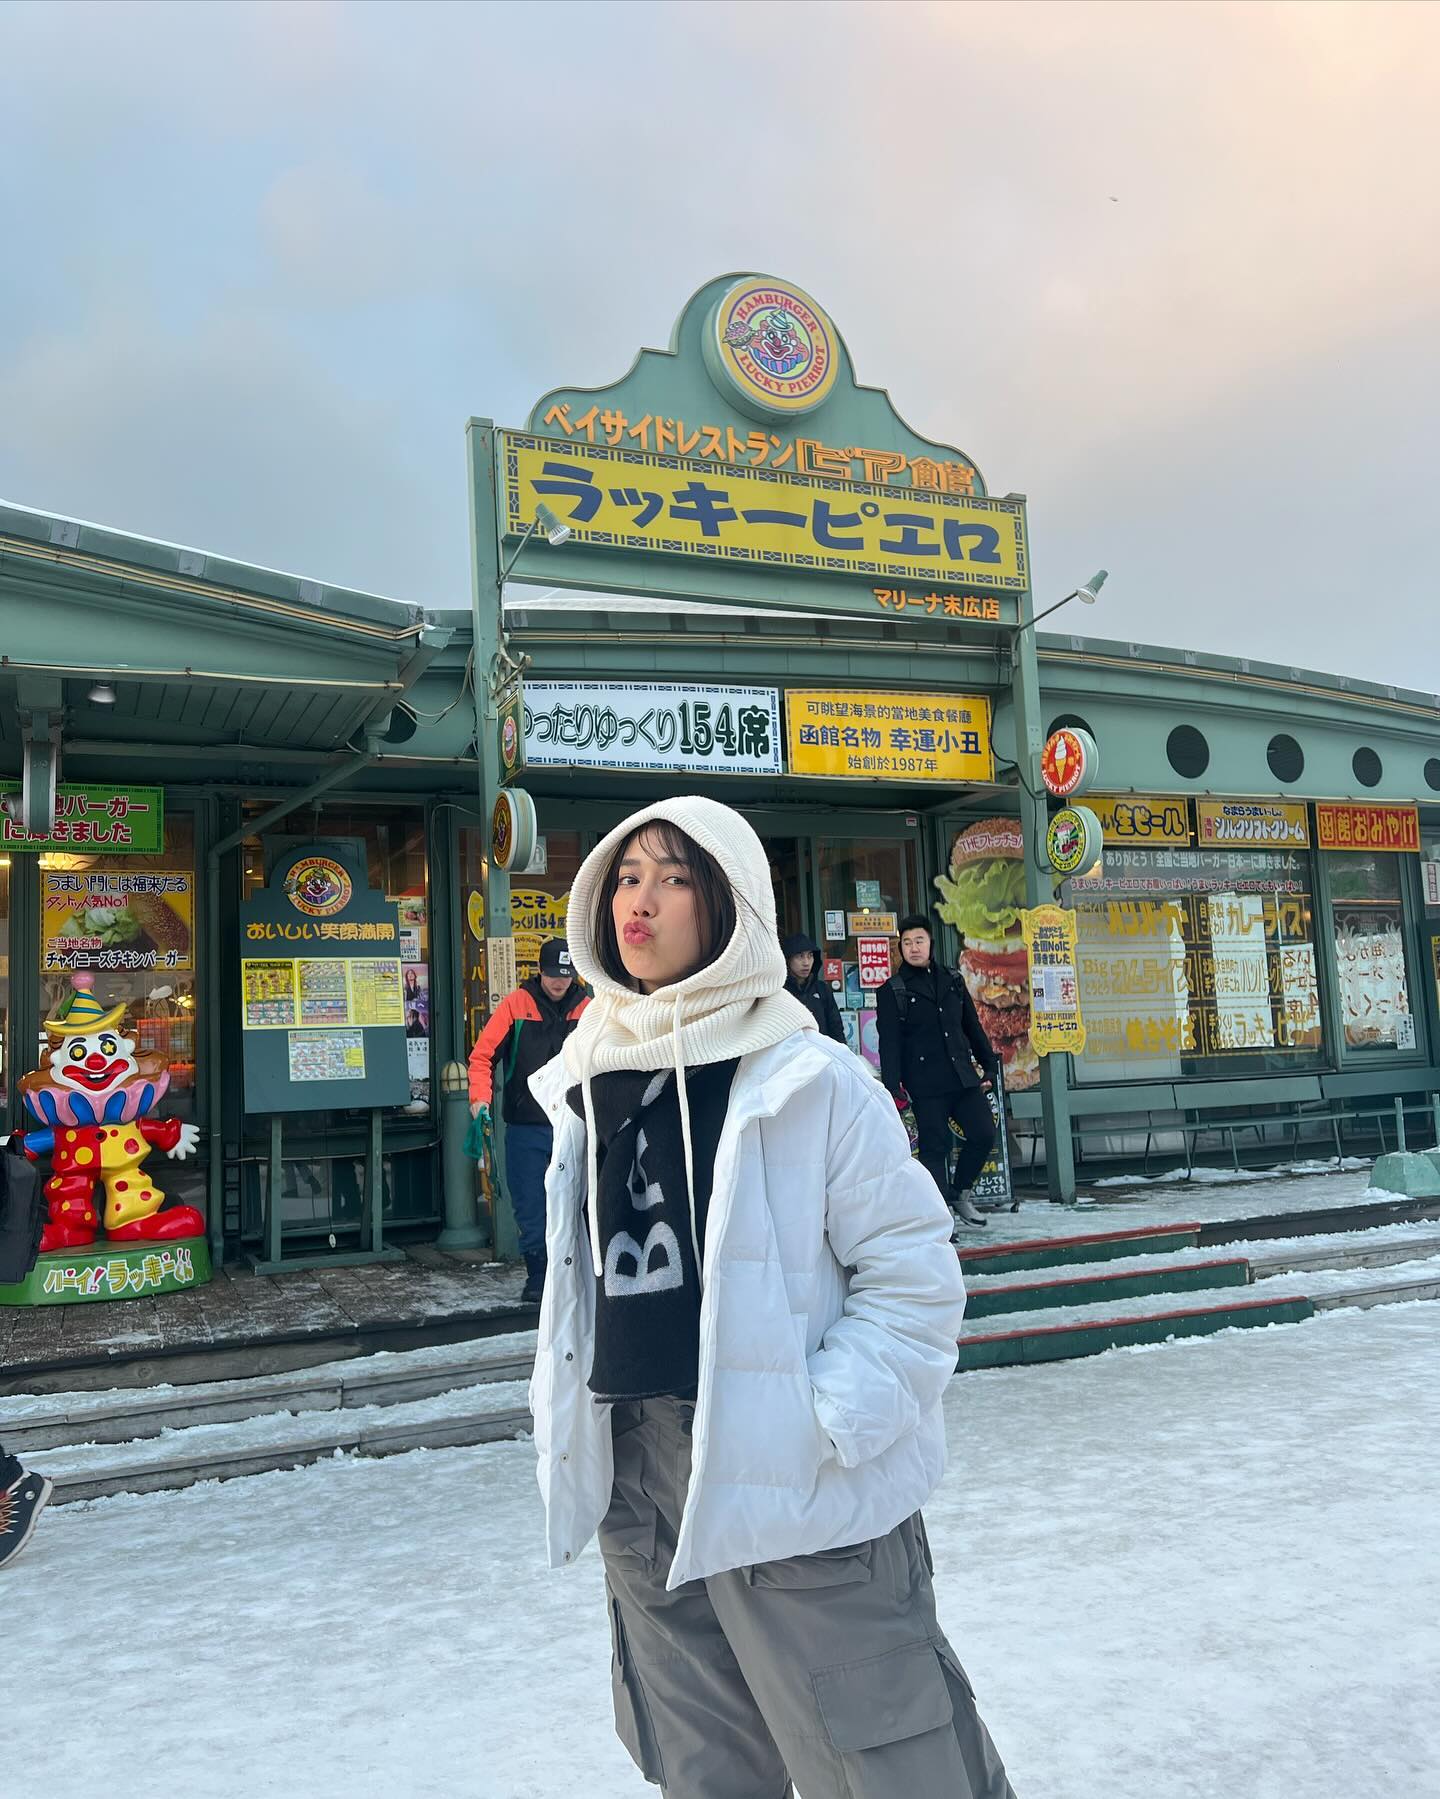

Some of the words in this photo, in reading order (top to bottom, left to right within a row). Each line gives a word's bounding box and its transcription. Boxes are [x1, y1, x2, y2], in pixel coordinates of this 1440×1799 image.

[737, 293, 817, 332] HAMBURGER
[740, 355, 784, 393] LUCKY
[788, 345, 825, 393] PIERROT
[543, 404, 795, 468] ベイサイドレストラン
[530, 461, 1002, 564] ラッキーピエロ
[873, 587, 1001, 620] マリーナ末広店
[806, 700, 972, 724] 可眺望海景的當地美食餐廳
[800, 724, 881, 748] 函館名物
[889, 727, 982, 754] 幸運小丑
[848, 755, 937, 772] 始創於1987年
[4, 820, 132, 843] にきました
[1101, 804, 1185, 836] い生ビール
[1320, 811, 1415, 844] 函館おみやげ
[47, 875, 188, 896] うまい門には福来たる
[511, 896, 548, 909] うこそ
[46, 937, 103, 949] ご当地名物
[246, 922, 395, 941] おいしい笑顔満開
[46, 951, 188, 969] チャイニーズチキンバーガー
[862, 966, 889, 982] OK
